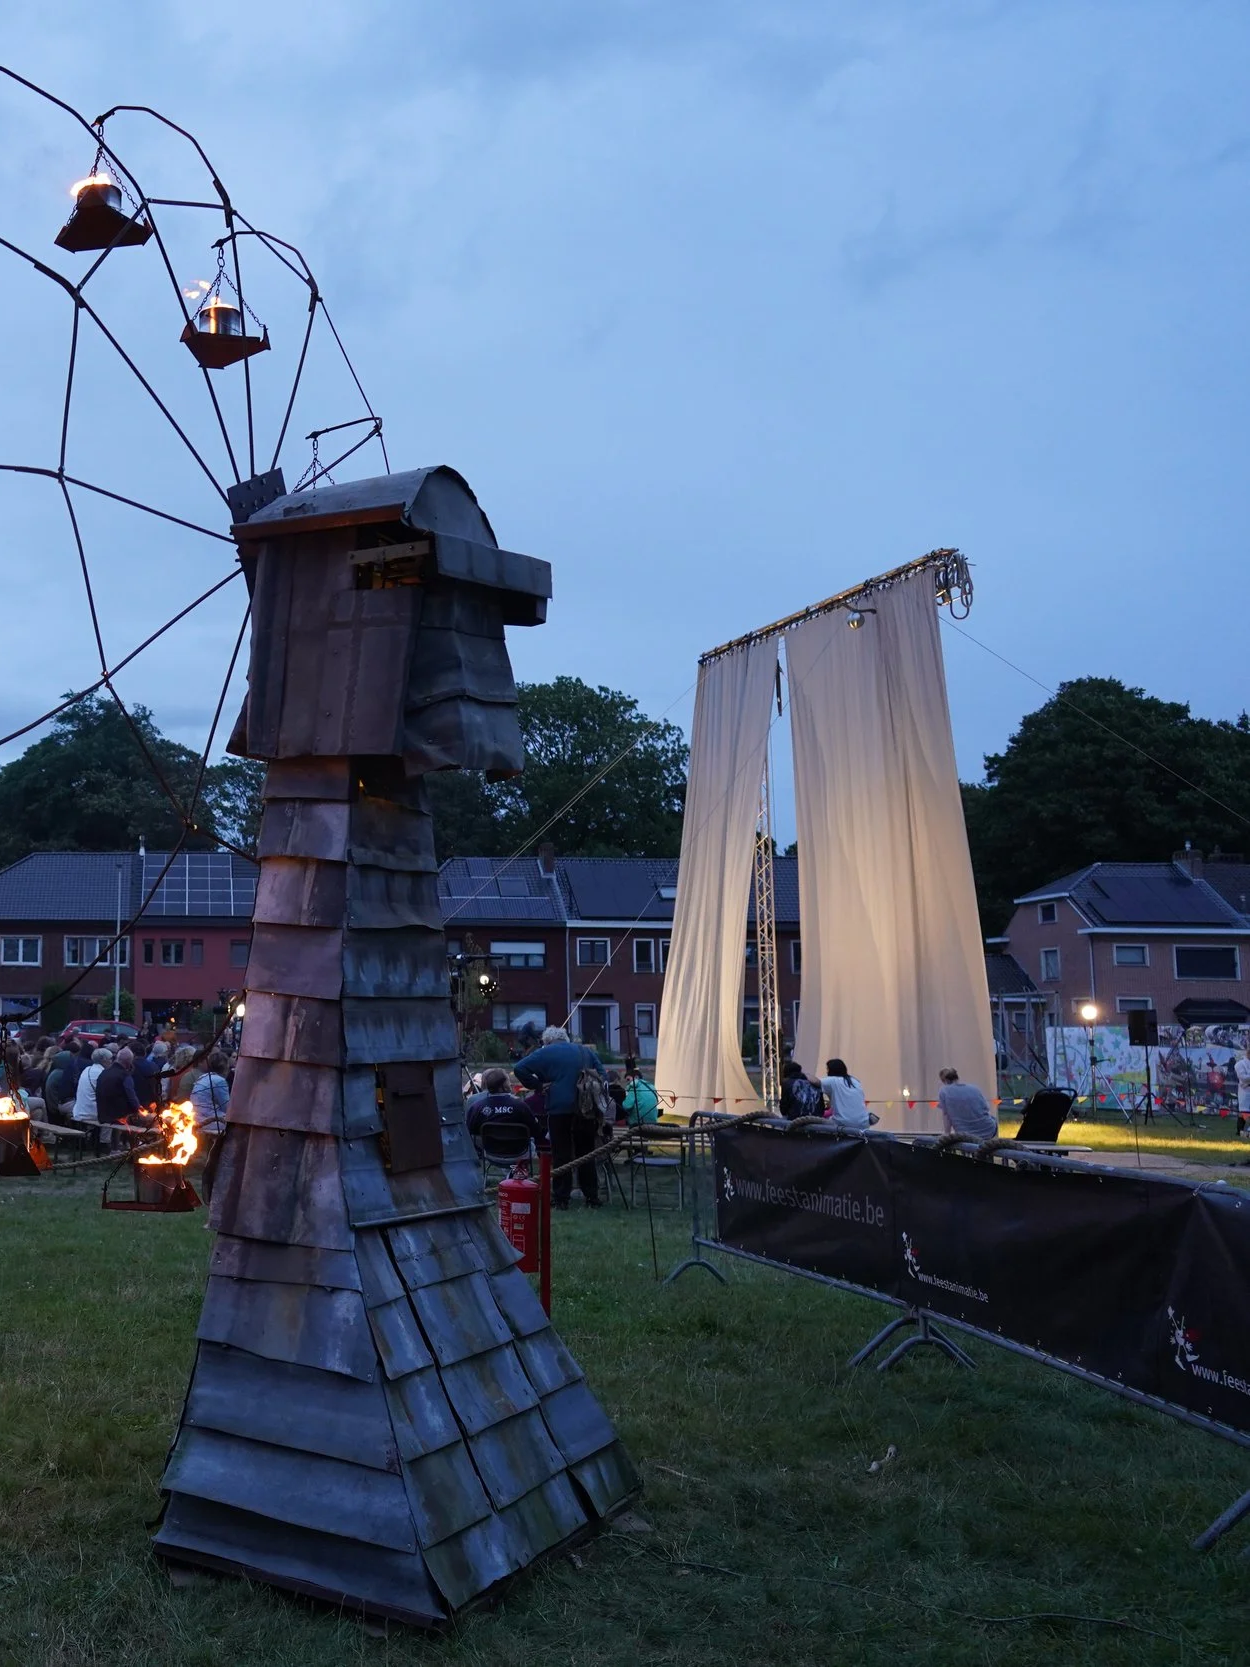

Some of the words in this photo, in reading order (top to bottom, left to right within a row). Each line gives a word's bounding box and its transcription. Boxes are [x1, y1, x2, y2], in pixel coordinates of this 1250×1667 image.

[494, 1106, 513, 1114] MSC
[735, 1178, 884, 1227] www.feestanimatie.be
[917, 1272, 989, 1303] www.feestanimatie.be
